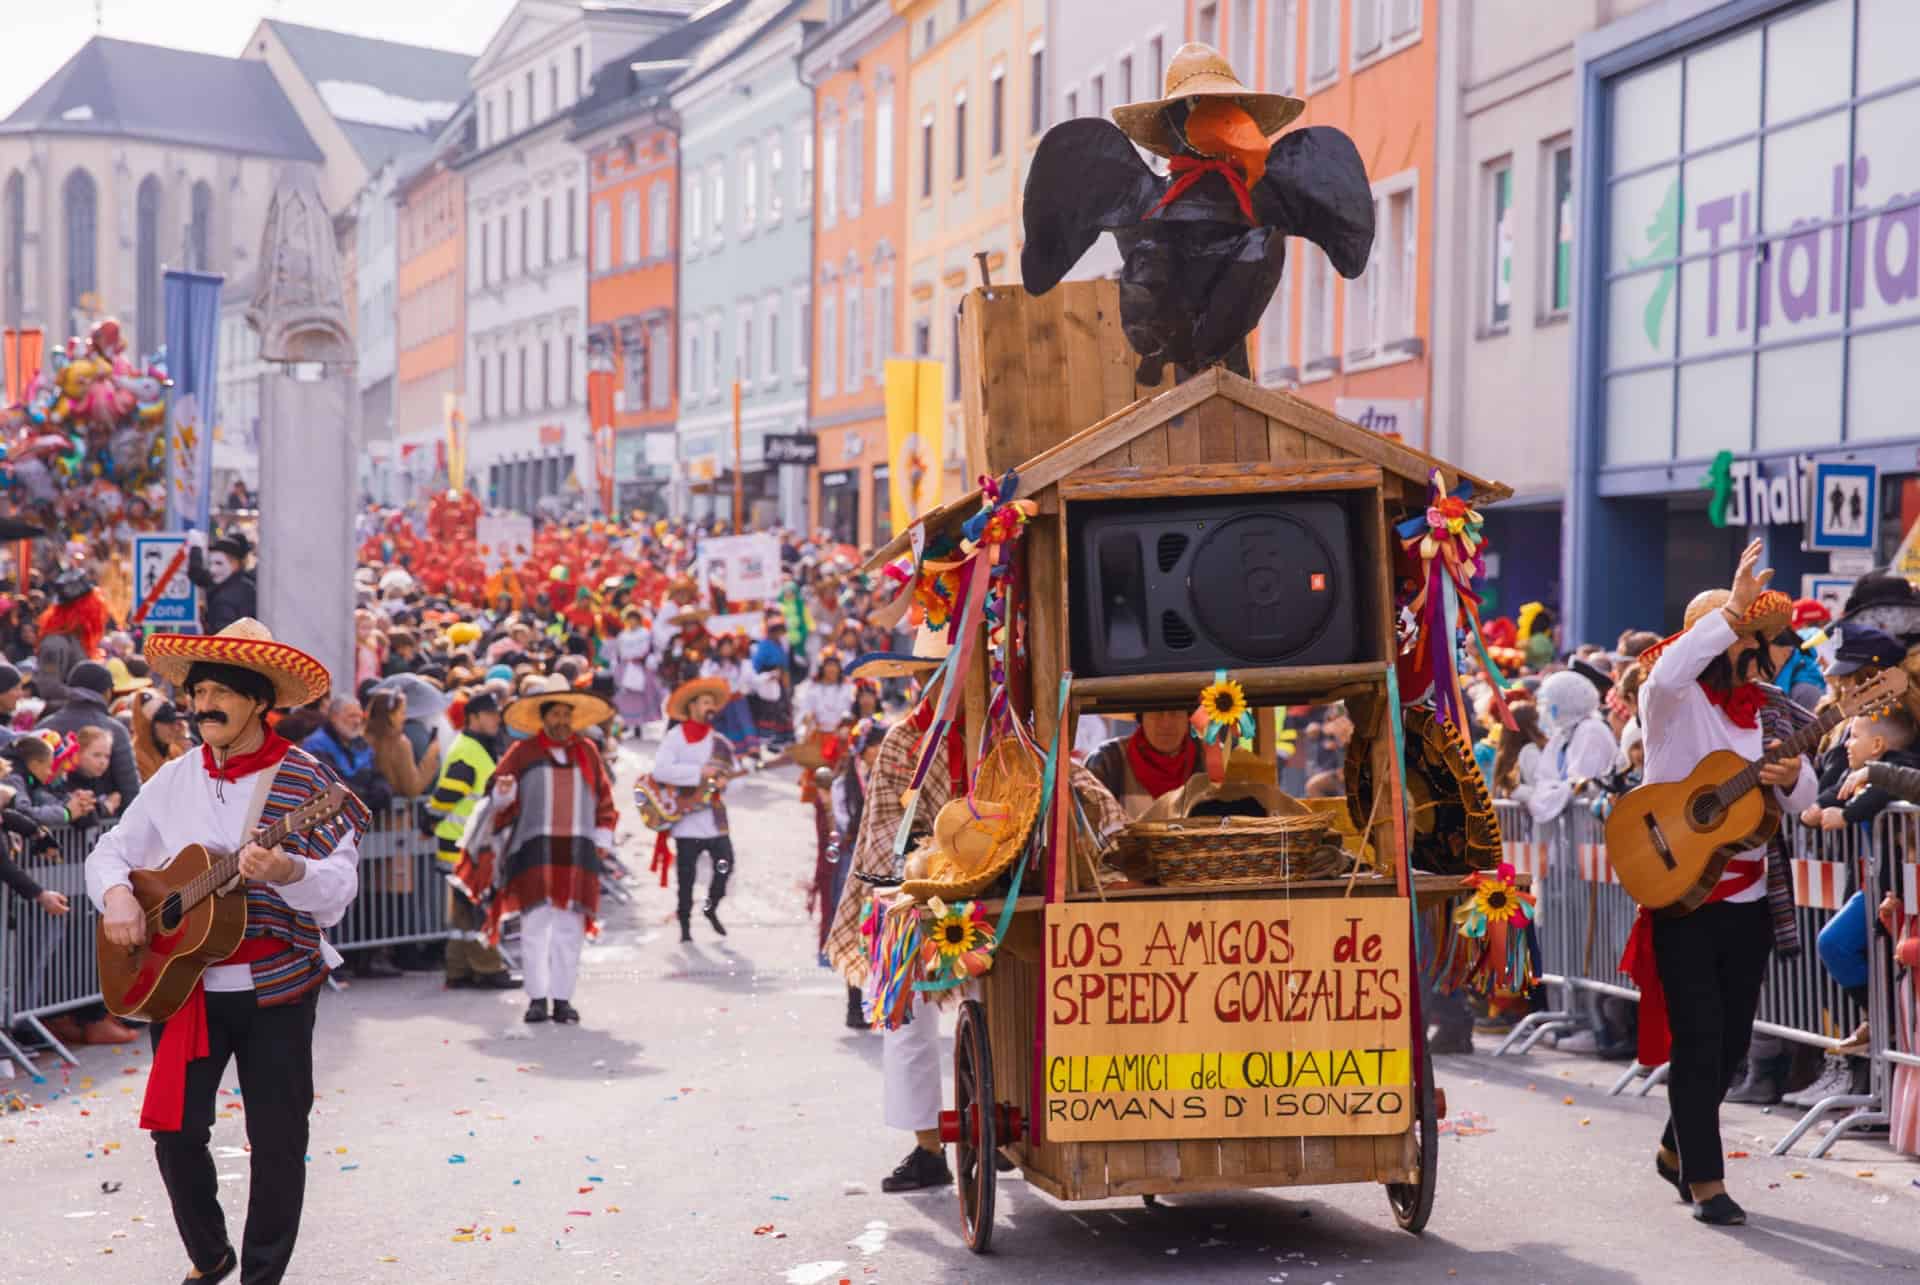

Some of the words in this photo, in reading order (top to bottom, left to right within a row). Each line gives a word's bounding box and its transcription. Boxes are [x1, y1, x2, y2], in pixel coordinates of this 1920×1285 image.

[1696, 155, 1920, 337] Thalia
[1358, 405, 1398, 433] dm
[1727, 455, 1808, 527] Thali
[1049, 922, 1123, 968] LOS
[1140, 919, 1295, 966] AMIGOS
[1333, 918, 1382, 963] de
[1053, 971, 1199, 1025] SPEEDY
[1214, 969, 1402, 1023] GONZALES
[1050, 1056, 1089, 1093] GLI
[1102, 1053, 1169, 1092] AMICI
[1191, 1052, 1227, 1090] del
[1242, 1048, 1397, 1088] QUAIAT
[1049, 1095, 1207, 1122] ROMANS
[1264, 1092, 1403, 1118] ISONZO
